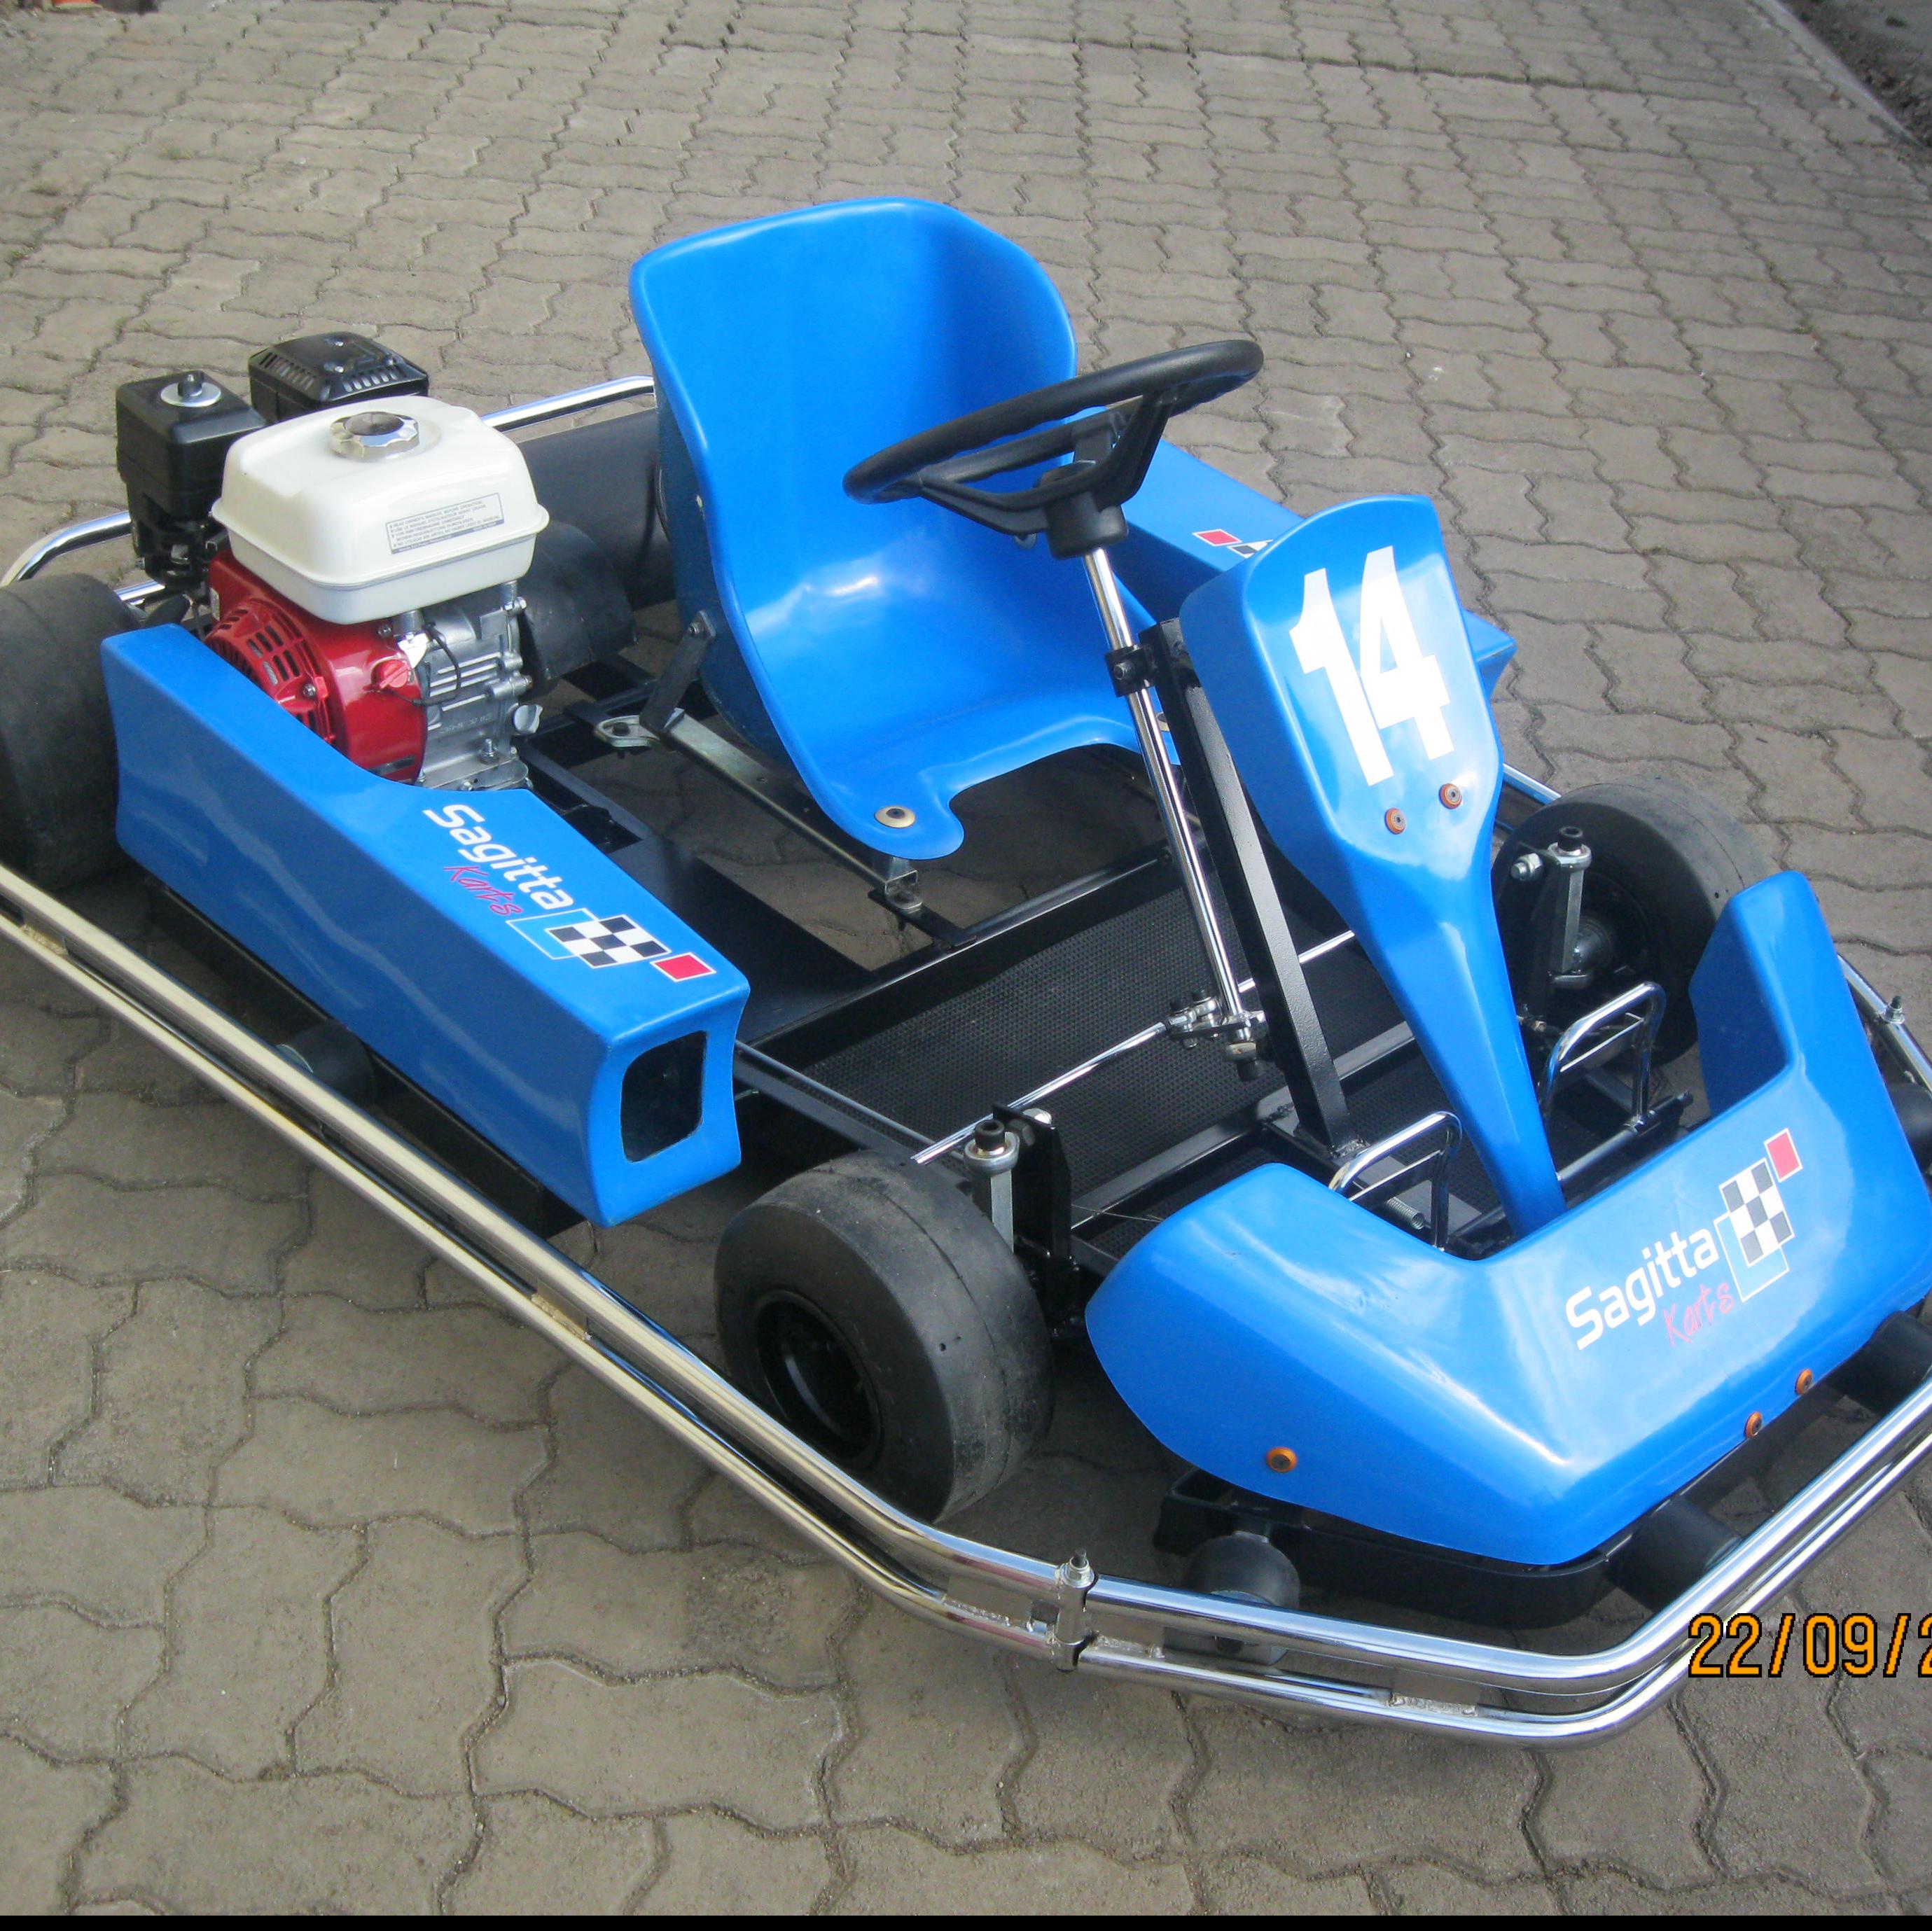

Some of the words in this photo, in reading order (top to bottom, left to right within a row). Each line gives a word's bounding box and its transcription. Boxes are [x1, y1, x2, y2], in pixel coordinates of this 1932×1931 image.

[1289, 545, 1454, 786] 14
[422, 804, 574, 910] Sagitta
[443, 865, 524, 916] Karts
[1565, 1228, 1720, 1351] Sagitta
[1661, 1281, 1735, 1348] Karts
